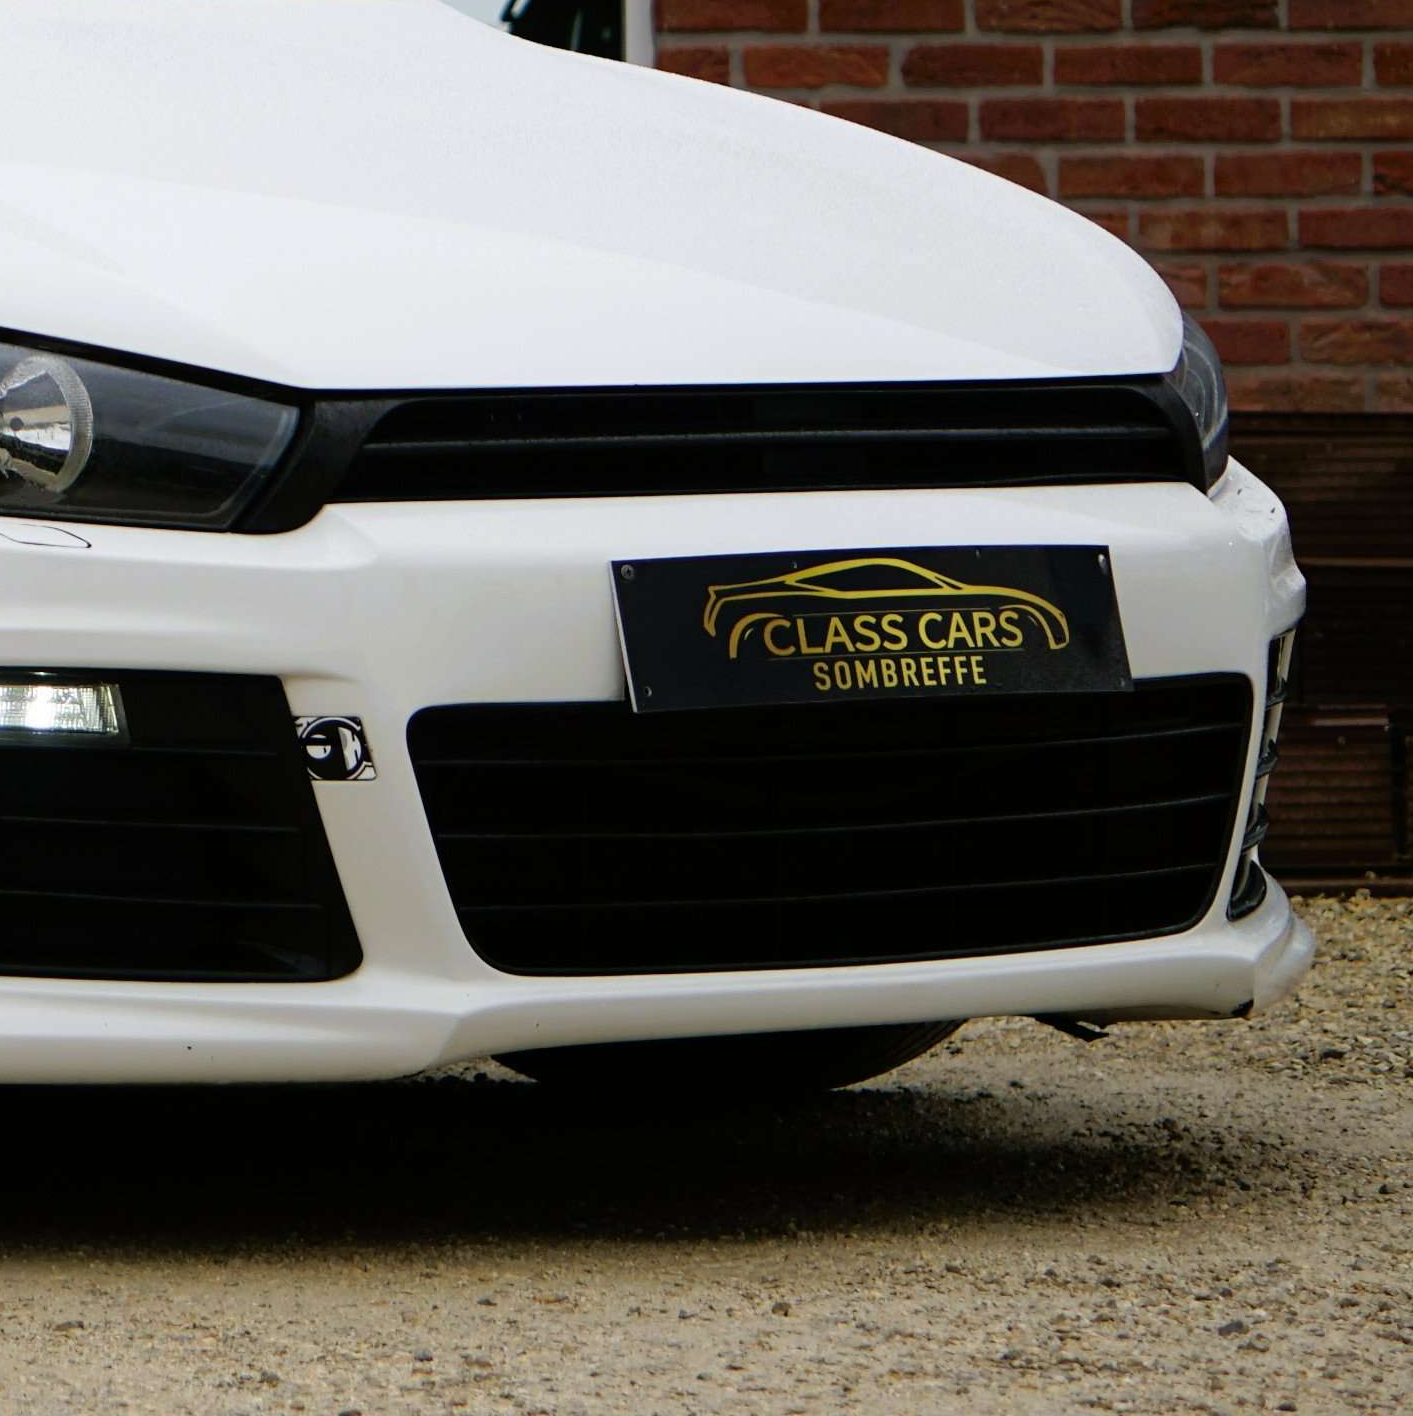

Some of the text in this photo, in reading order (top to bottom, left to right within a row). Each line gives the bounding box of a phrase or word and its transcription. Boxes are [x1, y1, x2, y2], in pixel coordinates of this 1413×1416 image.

[763, 610, 1023, 656] CLASS CARS
[813, 655, 987, 691] SOMBREFFE
